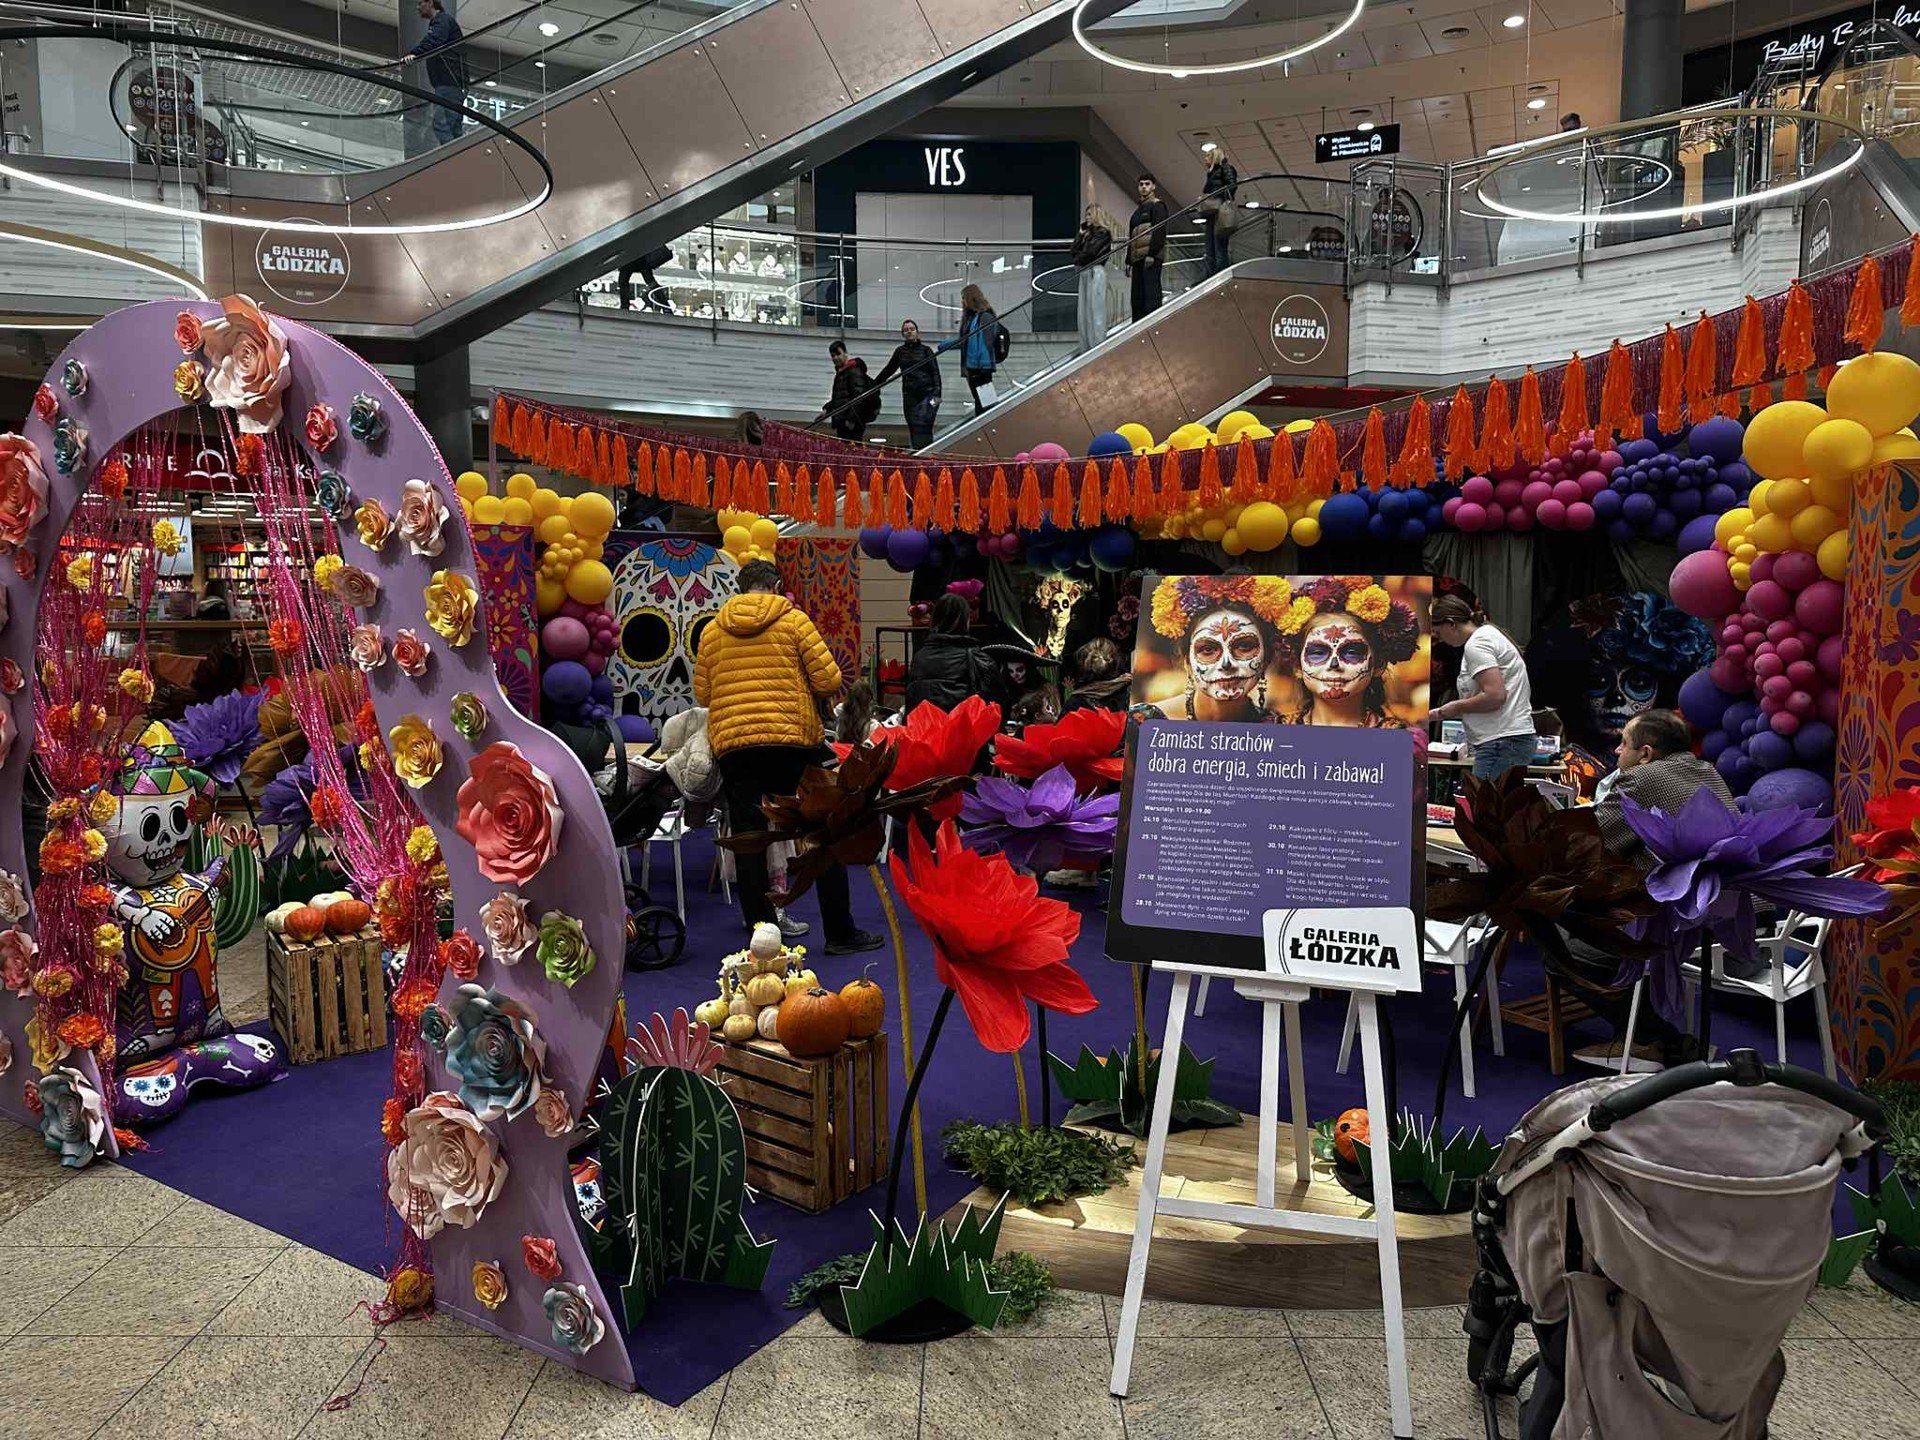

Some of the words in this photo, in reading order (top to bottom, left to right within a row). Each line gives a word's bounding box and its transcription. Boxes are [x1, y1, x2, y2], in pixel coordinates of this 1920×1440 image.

[1762, 33, 1825, 62] Betty
[925, 147, 966, 186] YES
[272, 245, 330, 259] GALERIA
[262, 253, 345, 275] ŁÓDZKA
[1274, 323, 1326, 339] ŁÓDZKA
[1281, 317, 1317, 327] GALERIA
[1150, 727, 1205, 750] Zamiast
[1210, 731, 1274, 752] strachów
[1148, 751, 1186, 774] dobra
[1192, 758, 1250, 782] energia,
[1256, 758, 1305, 780] śmiech
[1314, 762, 1317, 780] i
[1324, 760, 1384, 784] zabawa!
[1303, 927, 1380, 946] GALERIA
[1289, 937, 1400, 970] ŁÓDZKA
